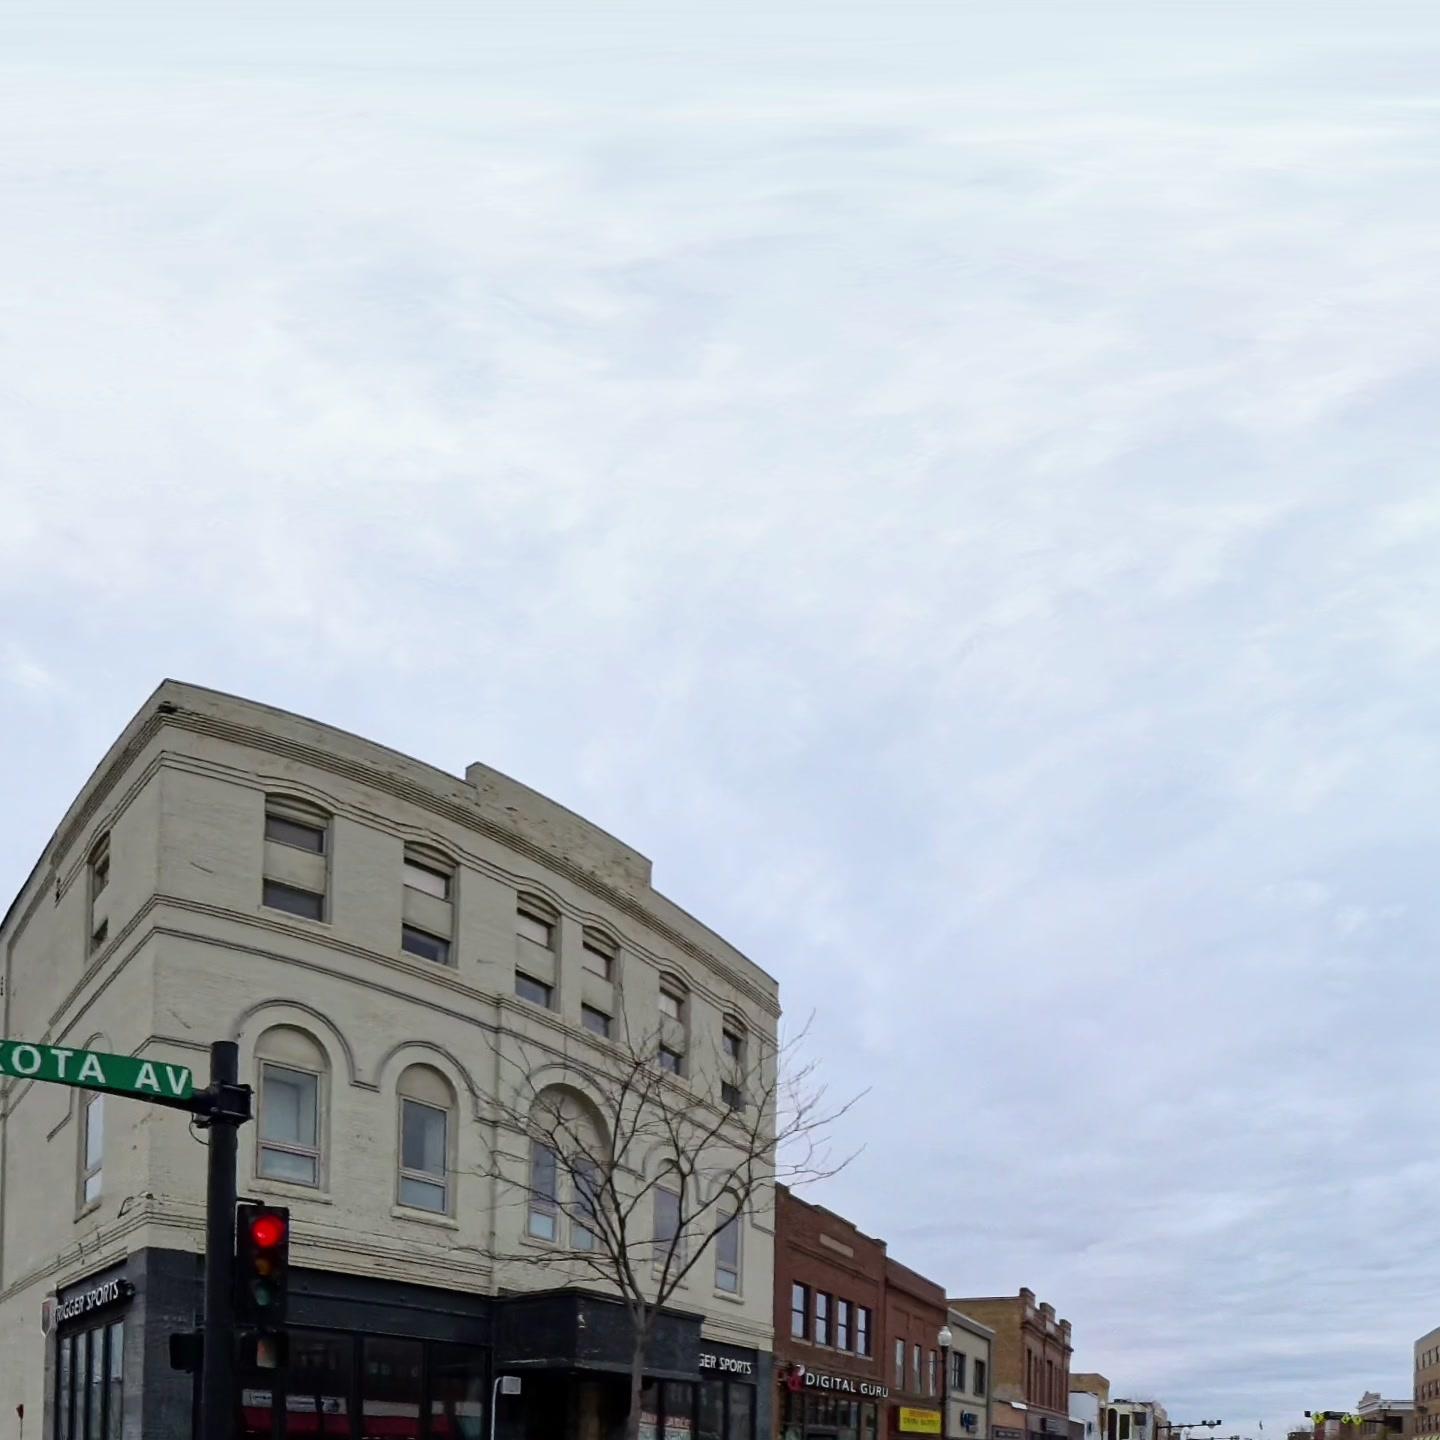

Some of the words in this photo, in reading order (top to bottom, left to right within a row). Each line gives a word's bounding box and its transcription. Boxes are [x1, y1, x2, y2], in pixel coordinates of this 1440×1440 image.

[0, 1042, 106, 1084] OTA
[135, 1062, 189, 1096] AV
[86, 1279, 119, 1310] SPORTS
[720, 1357, 752, 1375] SPORTS
[805, 1372, 857, 1393] DIGITAL
[860, 1383, 889, 1398] GURU
